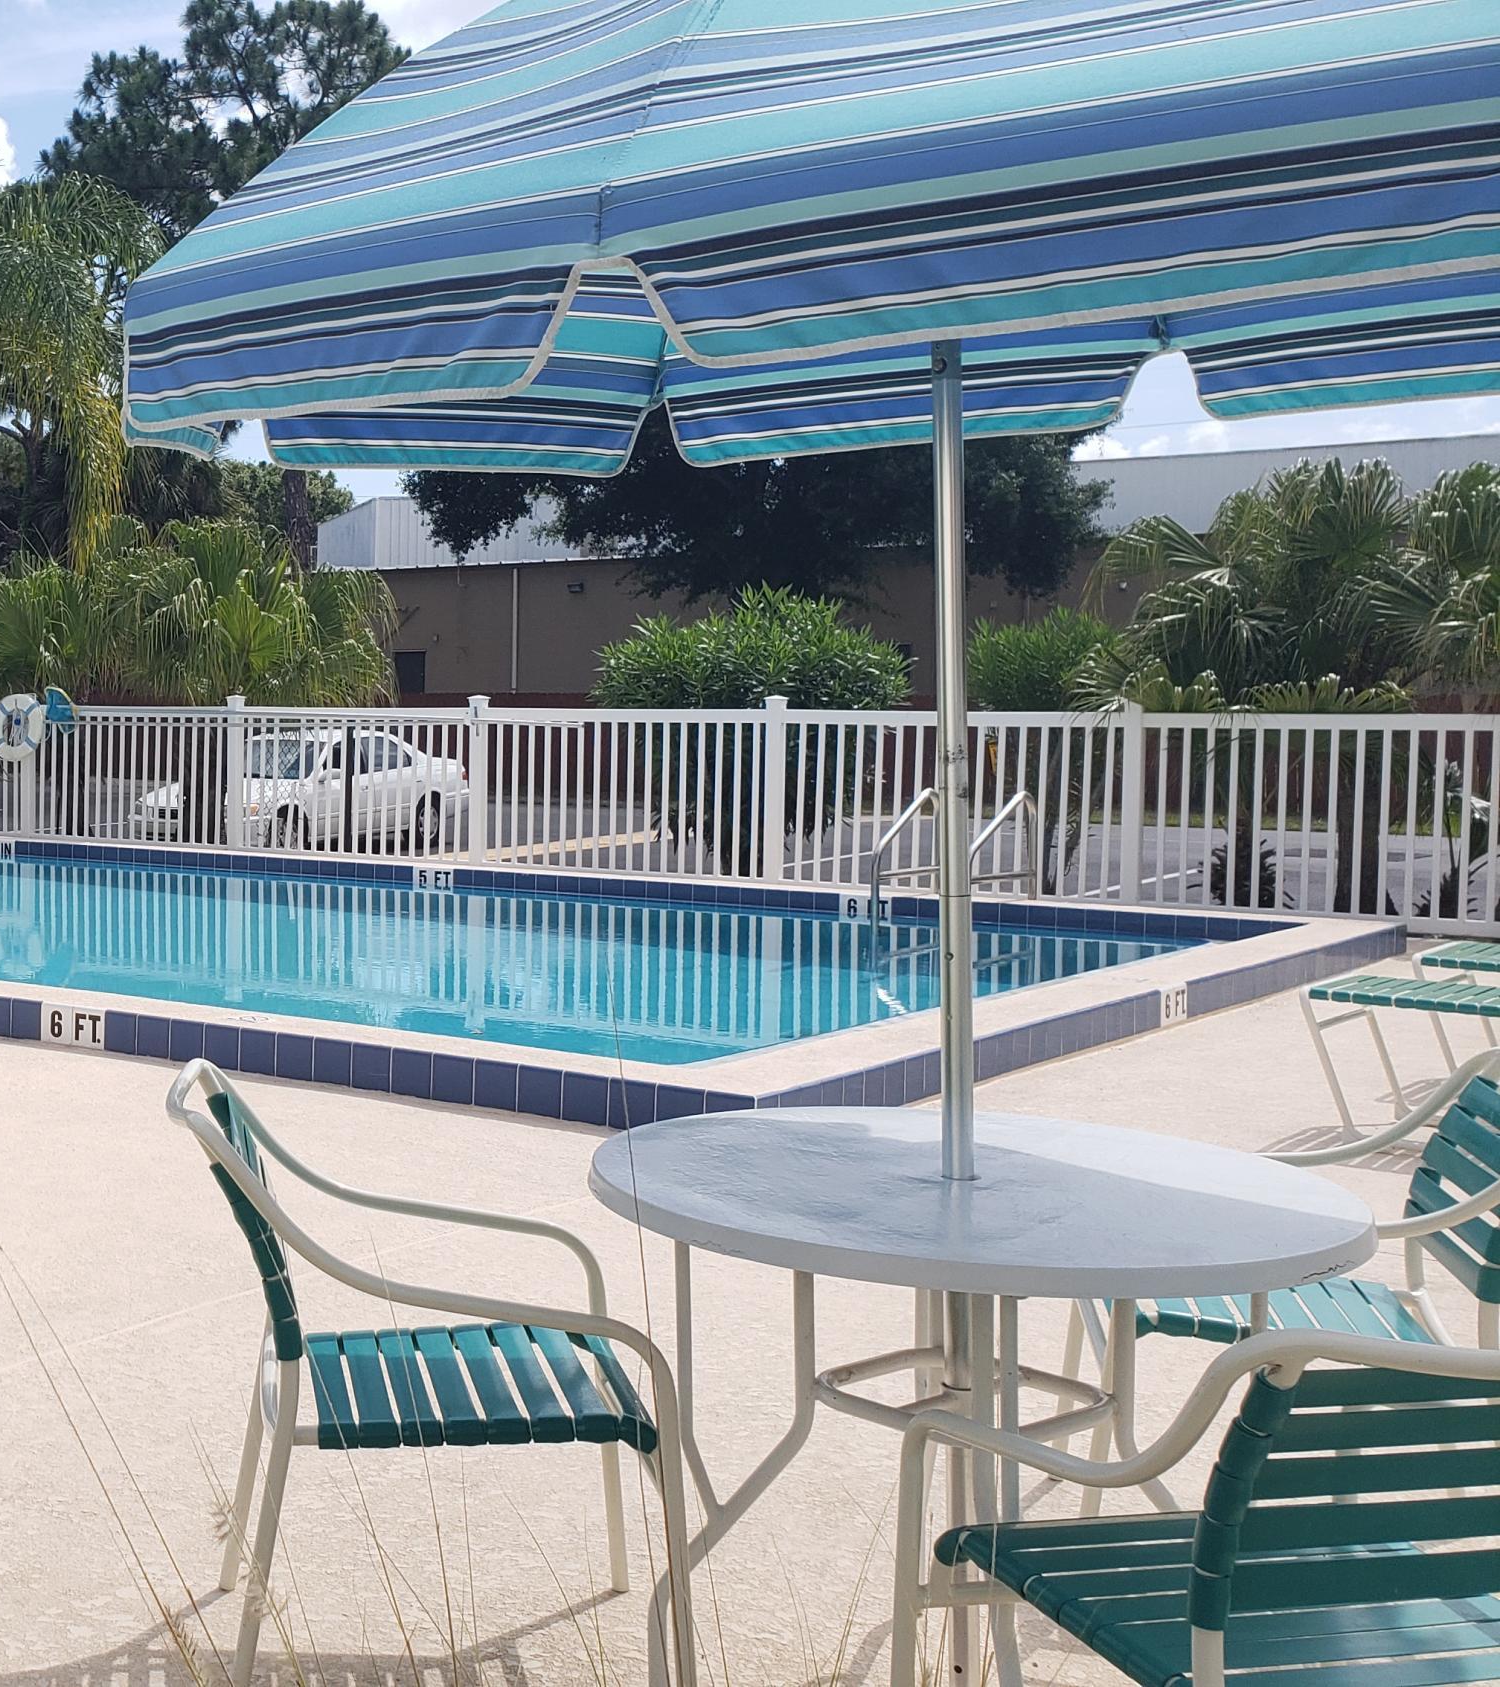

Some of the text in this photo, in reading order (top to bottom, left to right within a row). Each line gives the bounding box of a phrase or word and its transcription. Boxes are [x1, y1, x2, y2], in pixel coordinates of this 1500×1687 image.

[418, 869, 427, 889] 5
[847, 898, 858, 919] 6
[1165, 993, 1171, 1019] 6
[50, 1010, 101, 1044] 6 FT.
